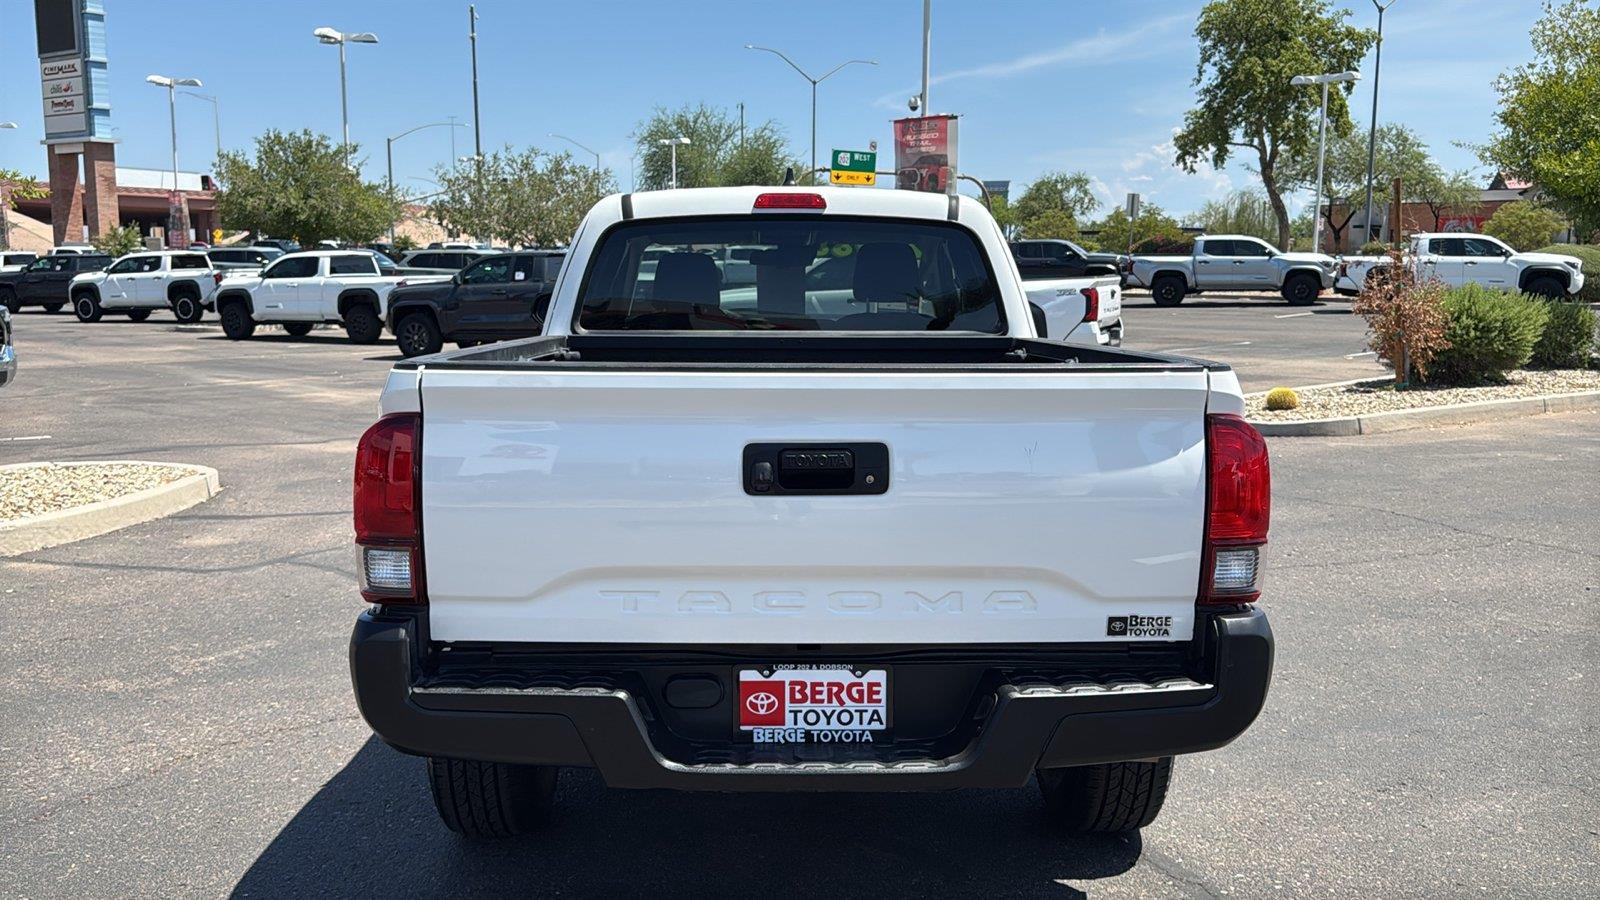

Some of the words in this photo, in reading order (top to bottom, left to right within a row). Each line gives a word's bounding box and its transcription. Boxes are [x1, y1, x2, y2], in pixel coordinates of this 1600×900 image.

[853, 153, 871, 162] WEST
[784, 454, 850, 467] TOYOTA
[600, 589, 1038, 615] TACOMA
[1128, 615, 1172, 627] BERGE
[1128, 628, 1170, 637] TOYOTA
[788, 680, 883, 707] BERGE
[788, 709, 884, 726] TOYOTA
[752, 728, 806, 744] BERGE
[811, 730, 873, 743] TOYOTA
